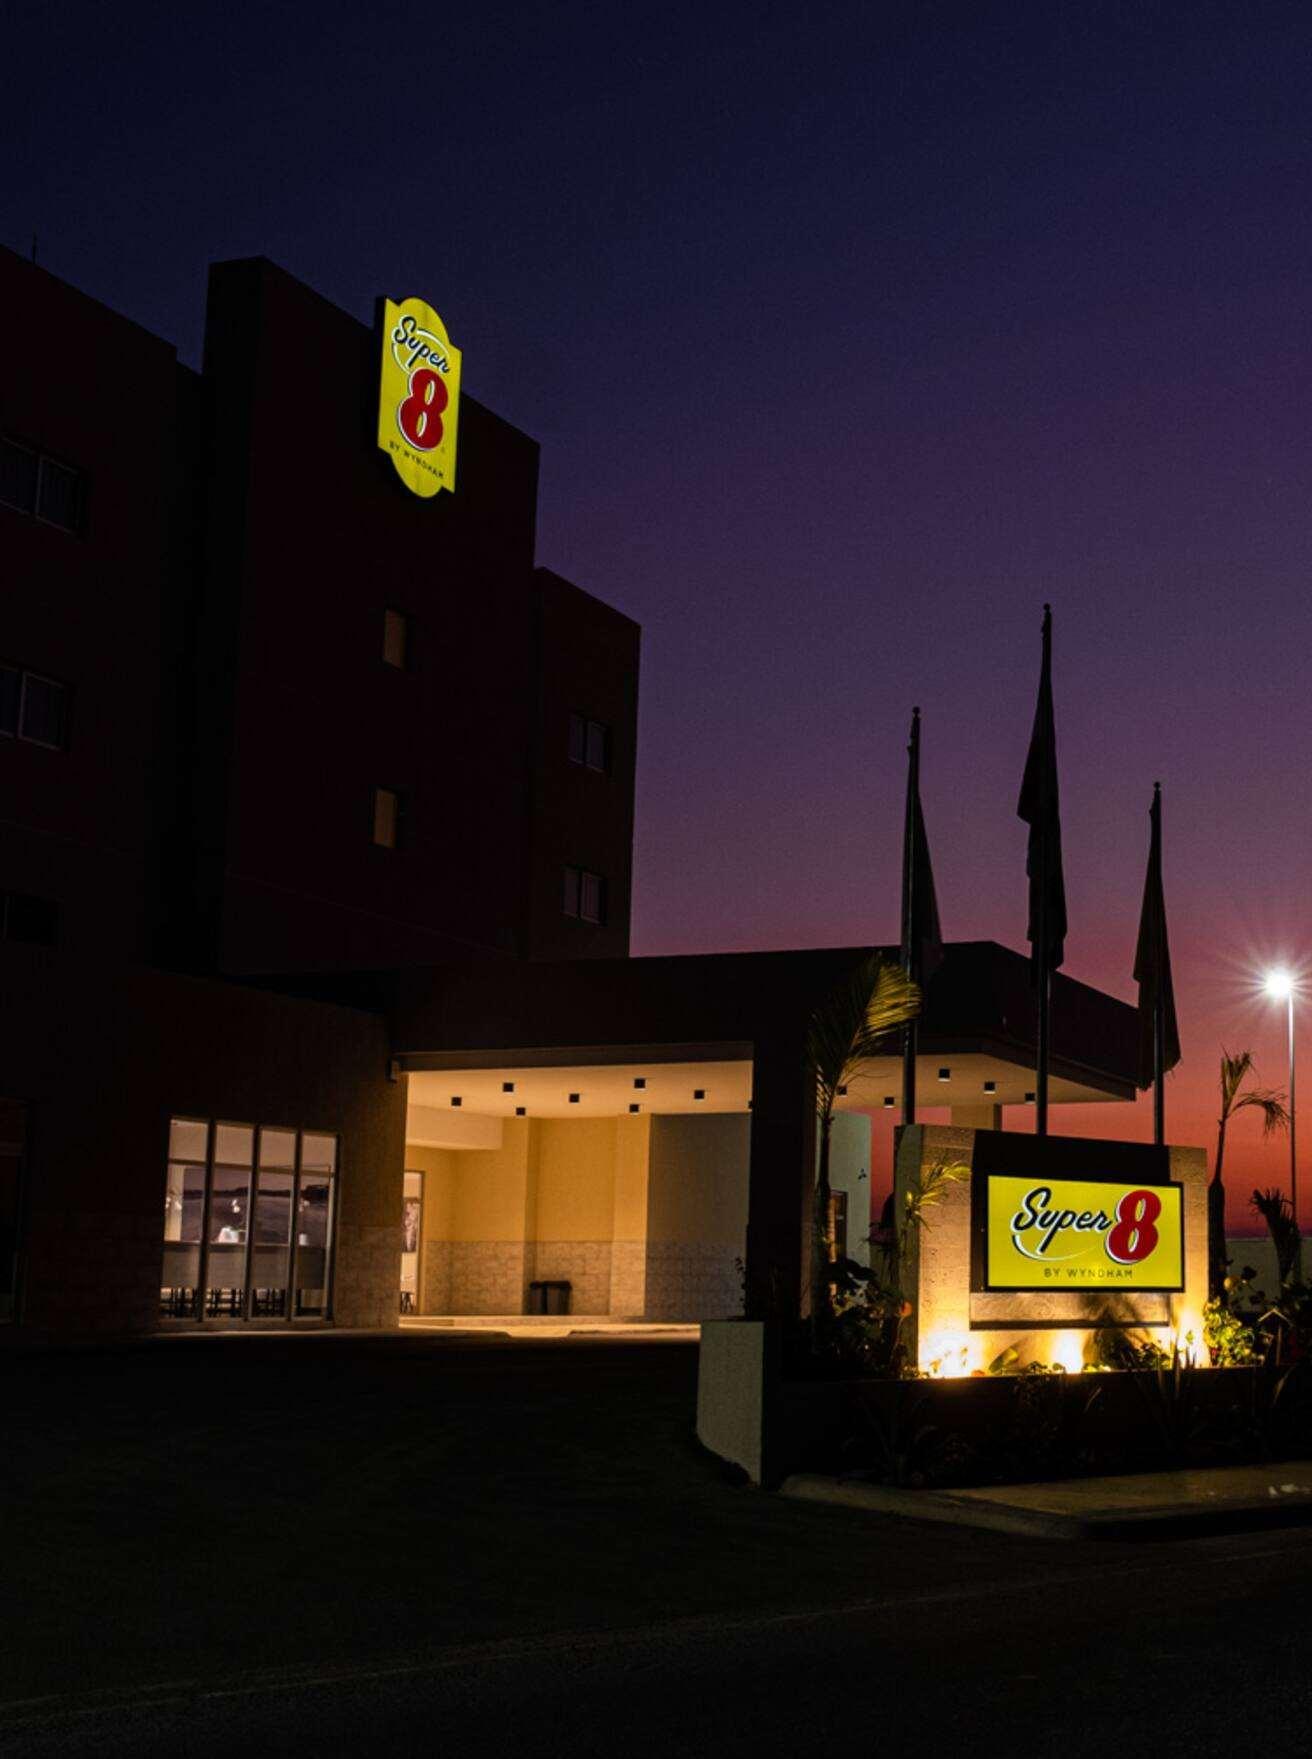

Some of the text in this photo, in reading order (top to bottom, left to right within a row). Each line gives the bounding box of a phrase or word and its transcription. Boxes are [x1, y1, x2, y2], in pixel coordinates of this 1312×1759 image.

[393, 315, 450, 374] Super
[398, 368, 449, 451] 8
[1011, 1186, 1162, 1265] Super 8
[1044, 1267, 1134, 1279] BY WYNDHAM
